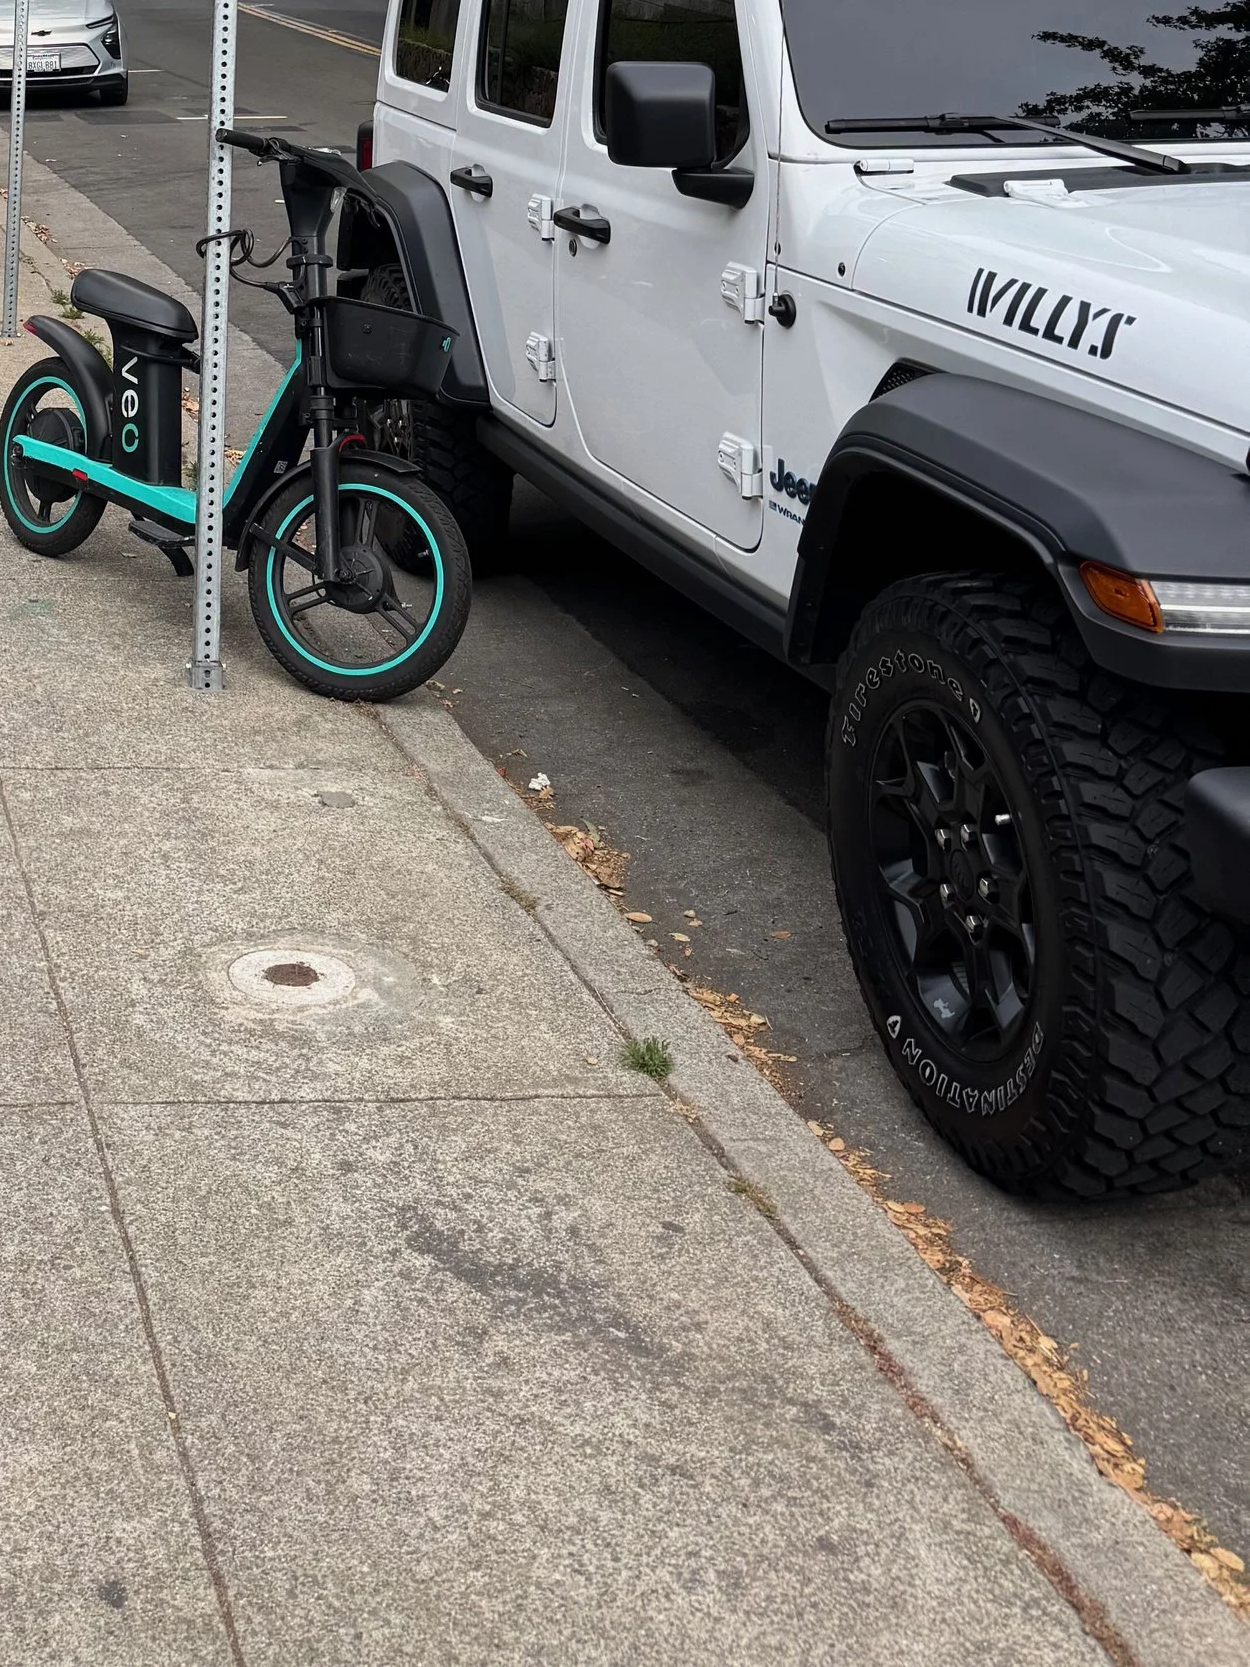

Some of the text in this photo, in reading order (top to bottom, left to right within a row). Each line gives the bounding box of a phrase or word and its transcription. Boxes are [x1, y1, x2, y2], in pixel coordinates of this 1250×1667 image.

[967, 267, 1137, 360] WILLYS
[121, 356, 139, 453] veo
[770, 458, 816, 506] Jee
[841, 649, 964, 747] Firestone
[902, 1021, 1044, 1116] DESTINATION
